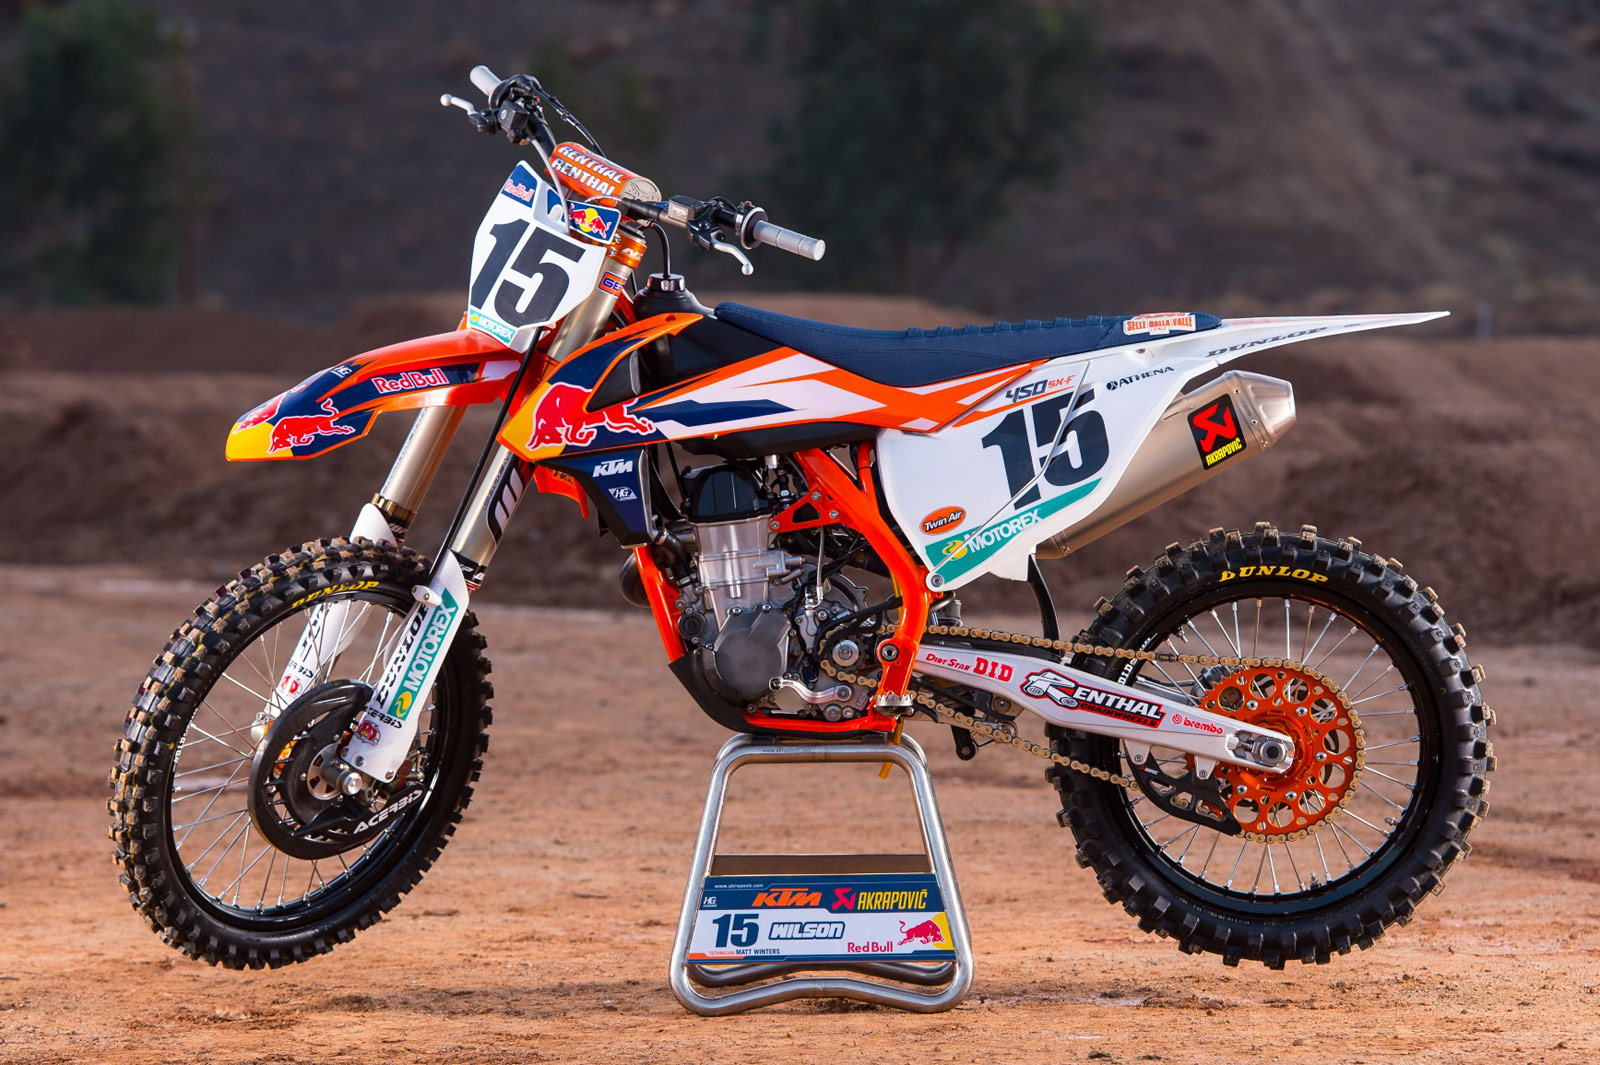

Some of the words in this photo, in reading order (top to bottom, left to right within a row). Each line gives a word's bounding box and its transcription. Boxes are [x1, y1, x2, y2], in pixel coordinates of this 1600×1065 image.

[557, 146, 625, 184] RENTHAL
[470, 218, 586, 328] 15
[477, 315, 515, 340] MOTOREX
[1126, 321, 1146, 331] SELLE
[1149, 319, 1170, 329] DALLA
[1172, 316, 1193, 327] VALLE
[1206, 327, 1328, 357] DUNLOP
[372, 373, 414, 393] Red
[409, 368, 449, 387] Bull
[1005, 379, 1048, 403] 450
[1048, 375, 1076, 388] SX-F
[1119, 366, 1175, 387] ATHENA
[981, 388, 1109, 510] 15
[592, 459, 633, 477] KTM
[924, 517, 947, 532] Twin
[948, 509, 963, 523] Air
[964, 509, 1042, 553] MOTOREX
[1219, 565, 1329, 582] DUNLOP
[403, 604, 457, 691] MOTOREX
[1080, 702, 1158, 728] CHAINWHEELS
[1184, 717, 1224, 735] brembo
[353, 789, 423, 834] ACERBIS
[752, 888, 822, 907] KTM
[712, 913, 760, 947] 15
[769, 922, 845, 940] WILSON
[847, 941, 869, 953] Red
[871, 941, 893, 953] Bull
